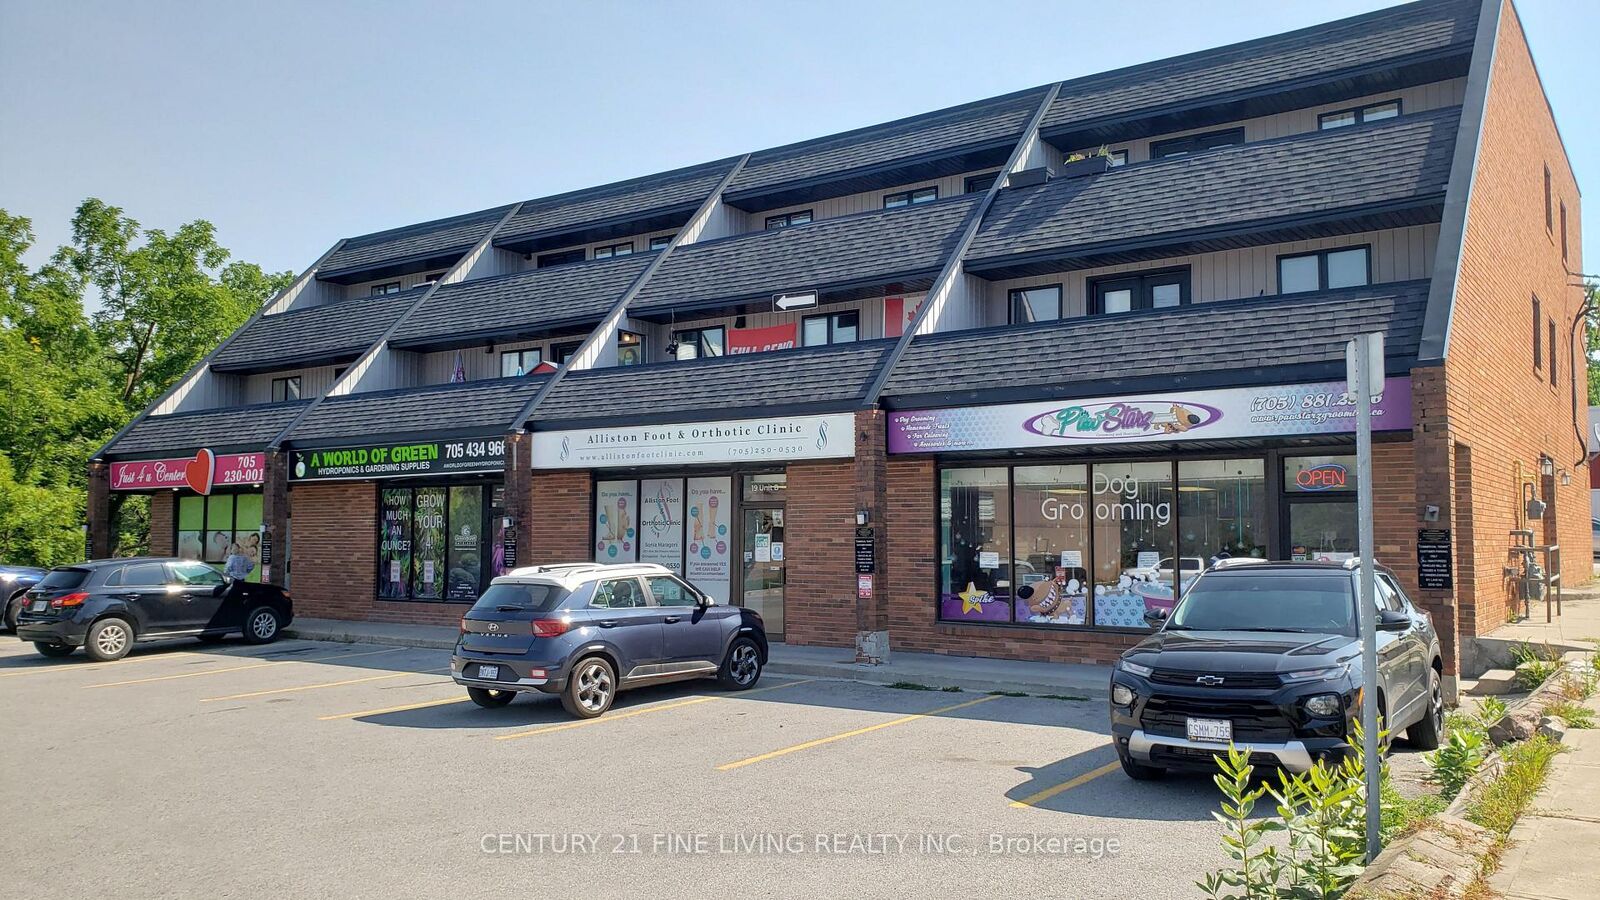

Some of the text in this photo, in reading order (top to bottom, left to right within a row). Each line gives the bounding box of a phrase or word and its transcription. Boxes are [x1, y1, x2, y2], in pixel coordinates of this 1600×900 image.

[1250, 392, 1383, 412] (705) 881.26
[899, 415, 936, 424] Dog Grooming
[587, 423, 802, 444] Alliston Foot & Orthotic Clinic
[310, 443, 438, 467] A WORLD OF GREEN
[445, 443, 464, 459] 705
[466, 441, 486, 457] 434
[579, 446, 803, 461] www.allistonfootclinic.com (705)250-0530
[238, 455, 256, 469] 705
[318, 465, 360, 475] HYDROPONICS
[365, 463, 400, 473] GARDENING
[400, 461, 430, 471] SUPPLIES
[114, 462, 187, 488] Just 4 u Center
[223, 468, 264, 483] 230-001
[1296, 470, 1345, 486] OPEN
[751, 484, 758, 492] 19
[759, 483, 773, 492] Unit
[1092, 472, 1139, 500] Dog
[389, 495, 406, 505] HOW
[416, 494, 445, 508] GROW
[386, 510, 408, 521] MUCH
[418, 515, 443, 529] YOUR
[391, 526, 402, 536] AN
[381, 540, 411, 551] OUNCE?
[969, 592, 995, 604] Spike
